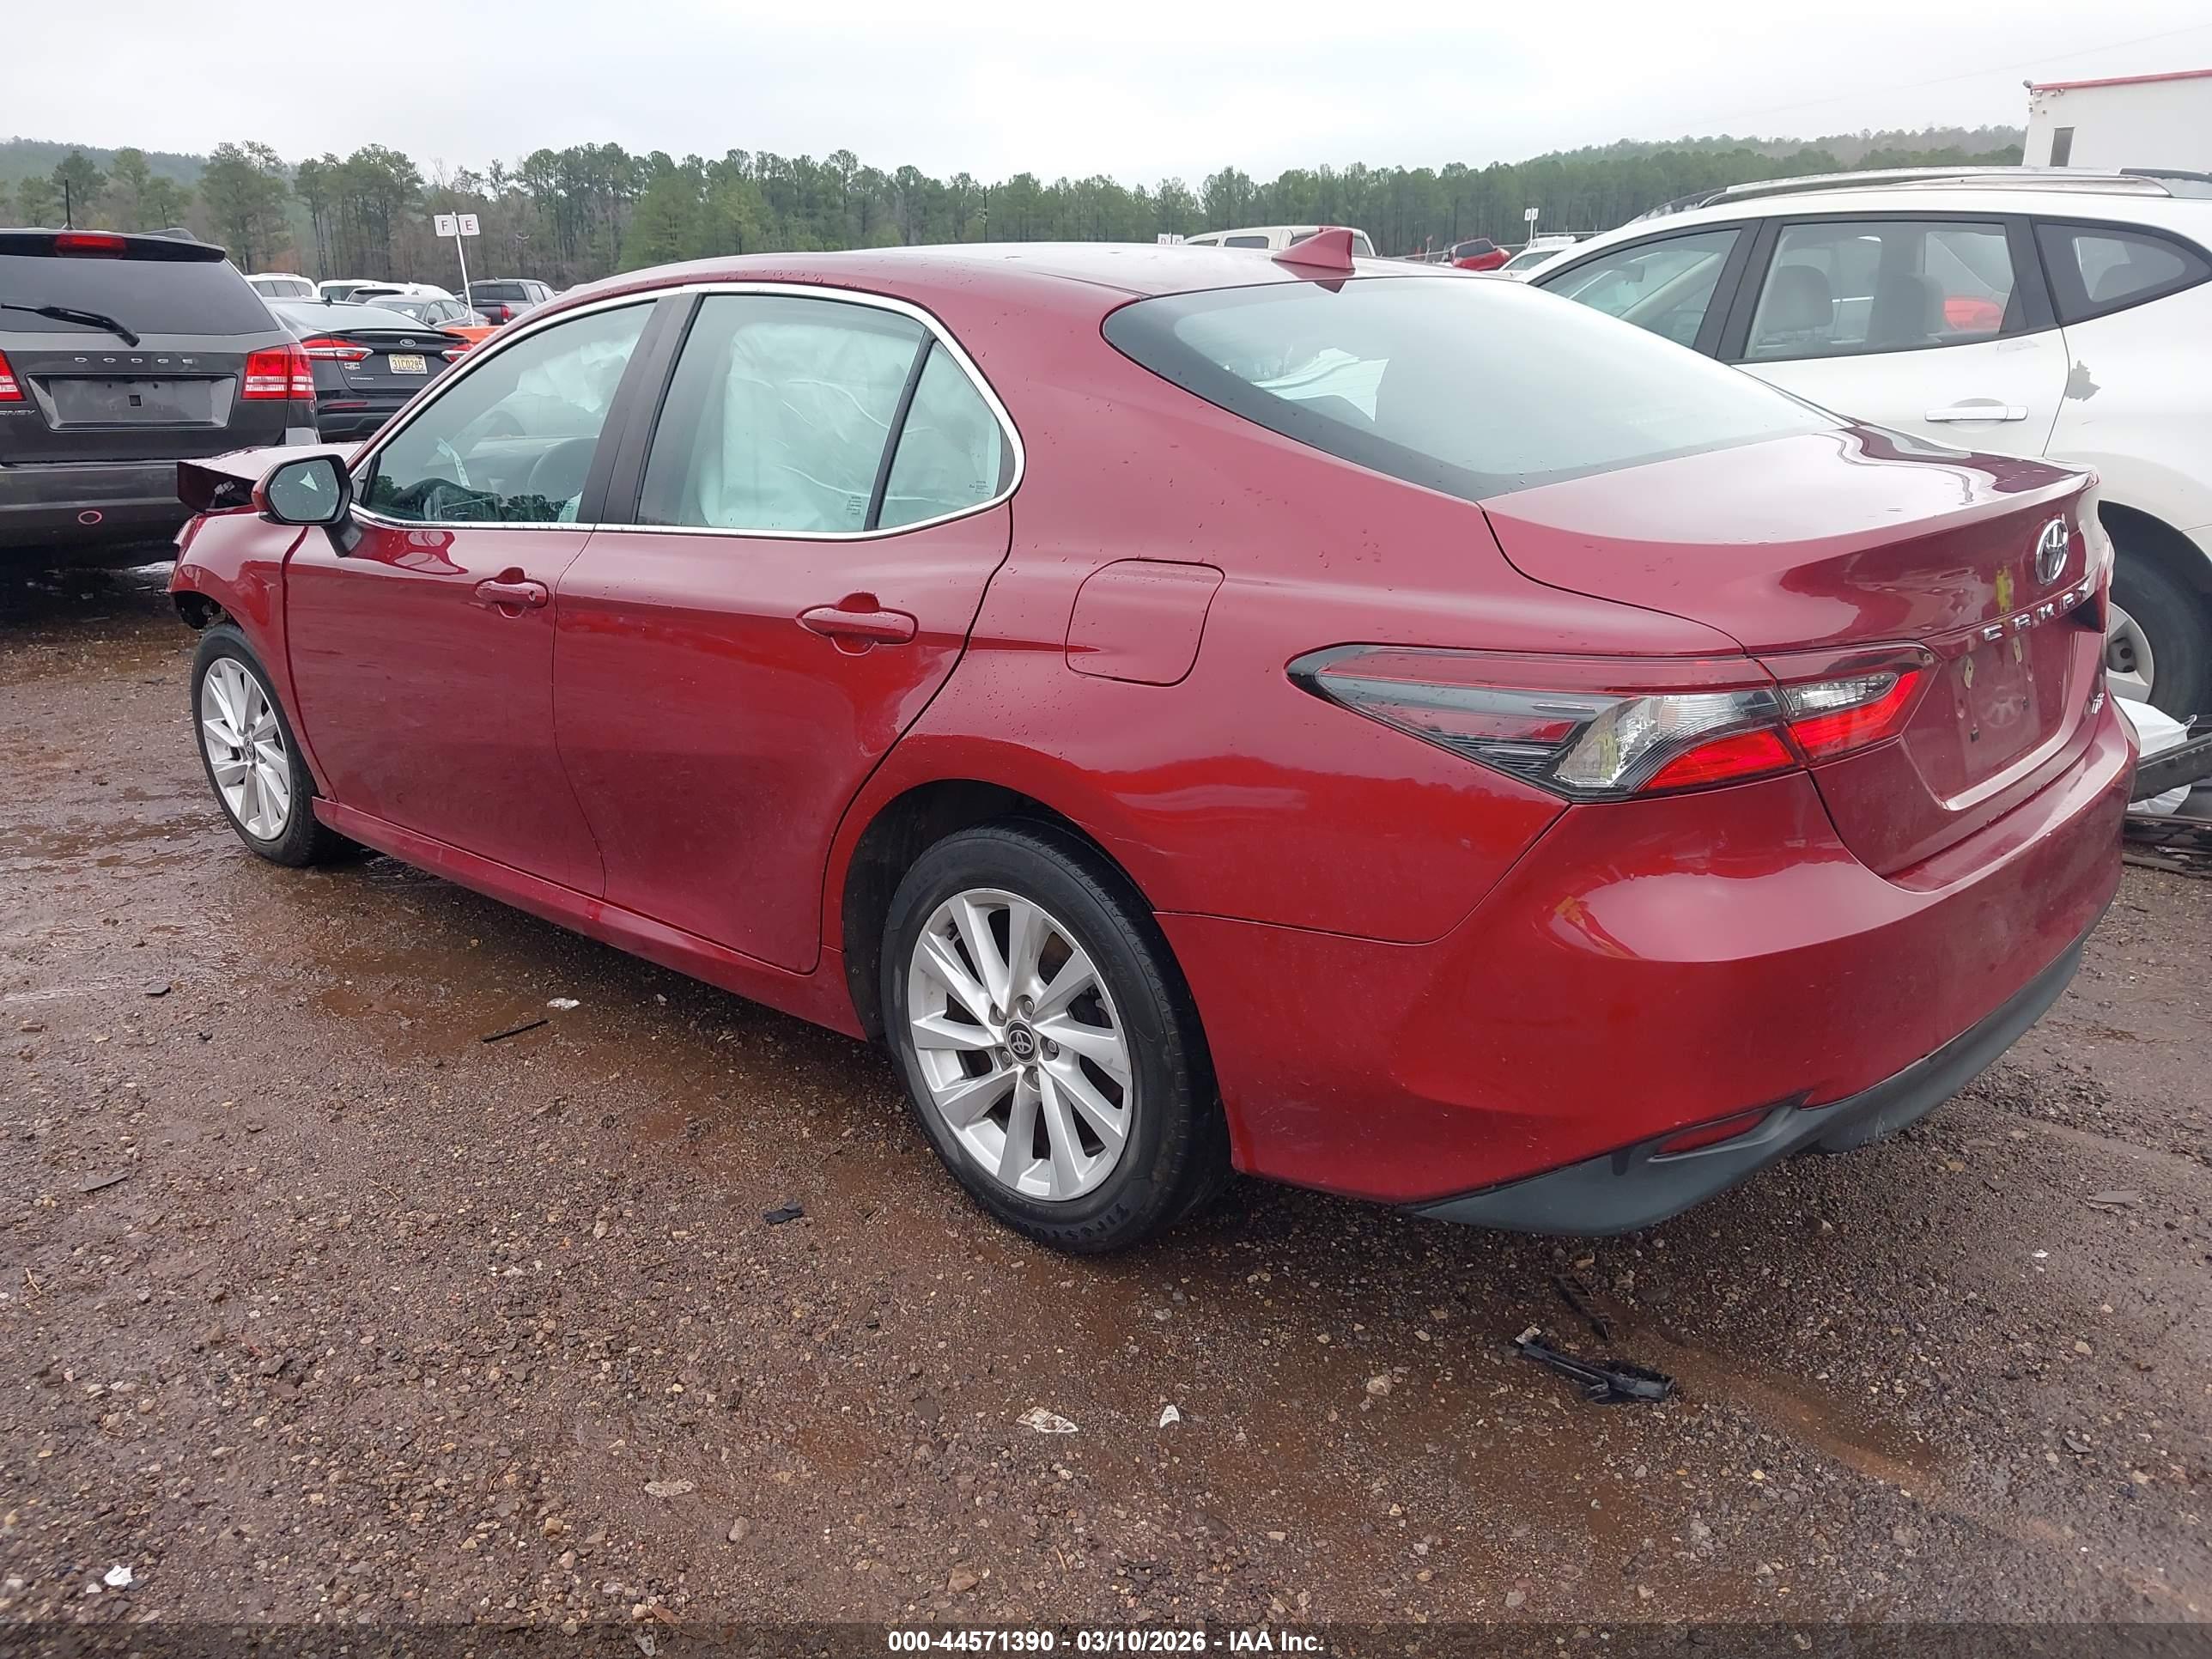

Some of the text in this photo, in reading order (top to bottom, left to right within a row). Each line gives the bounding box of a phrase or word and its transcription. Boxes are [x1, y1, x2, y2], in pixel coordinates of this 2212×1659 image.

[441, 220, 447, 231] F
[465, 220, 473, 230] E
[74, 356, 193, 365] DODGE
[1981, 582, 2089, 641] CAMRY
